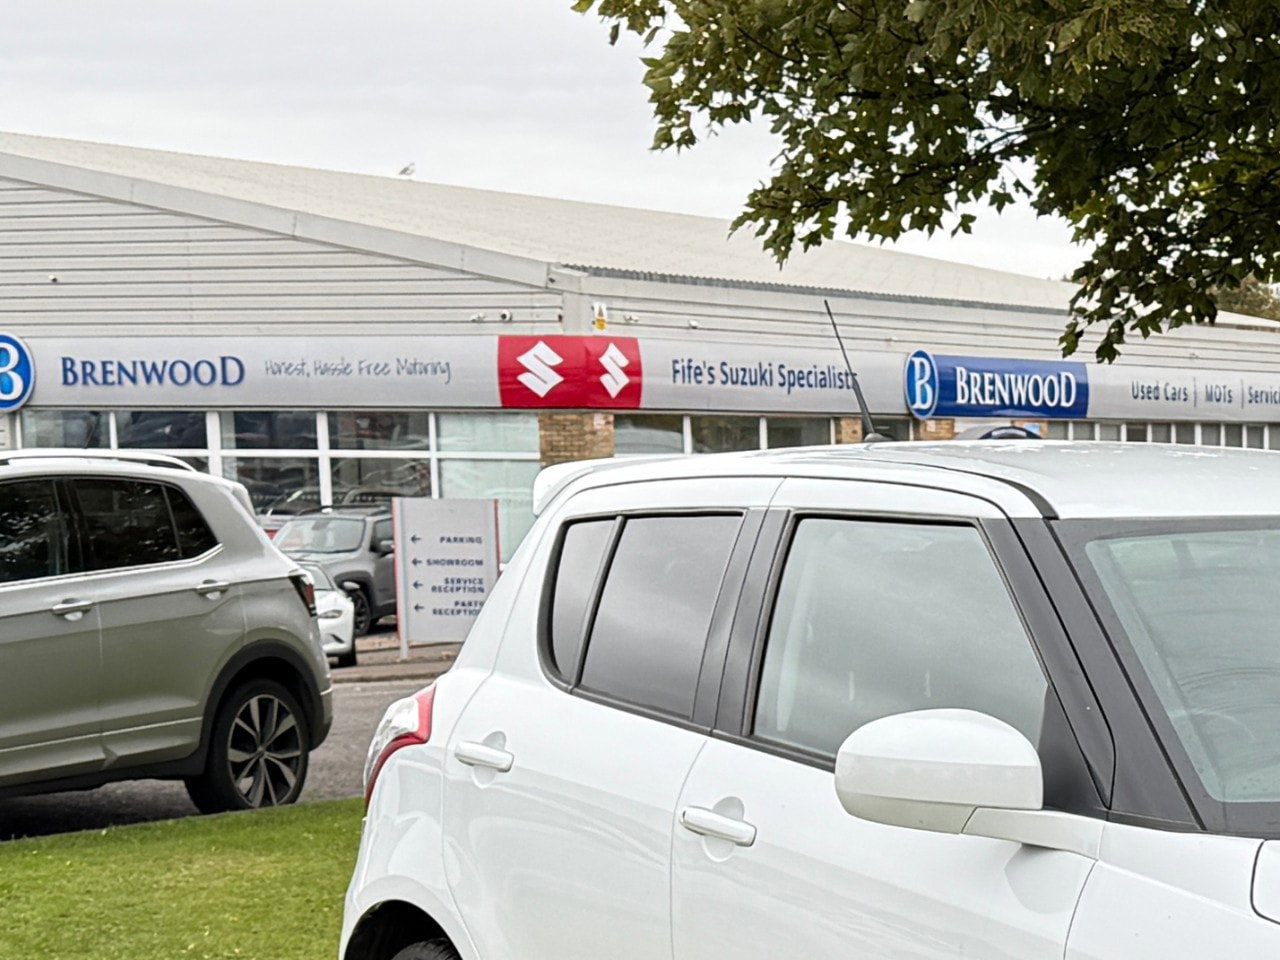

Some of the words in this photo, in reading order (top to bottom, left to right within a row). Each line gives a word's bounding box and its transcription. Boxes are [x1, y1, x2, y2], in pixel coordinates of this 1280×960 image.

[61, 356, 245, 387] BRENWOOD
[265, 360, 311, 378] Honest,
[314, 357, 353, 377] Hassle
[358, 359, 391, 376] Free
[396, 357, 451, 385] Motoring
[672, 359, 716, 384] Fife's
[720, 361, 774, 388] Suzuki
[955, 366, 1077, 408] BRENWOOD
[1131, 380, 1160, 401] Used
[1163, 382, 1189, 402] Cars
[1205, 384, 1233, 403] MOTs
[440, 536, 482, 544] PARKING
[431, 585, 485, 593] RECEPTION
[444, 577, 484, 585] SERVICE
